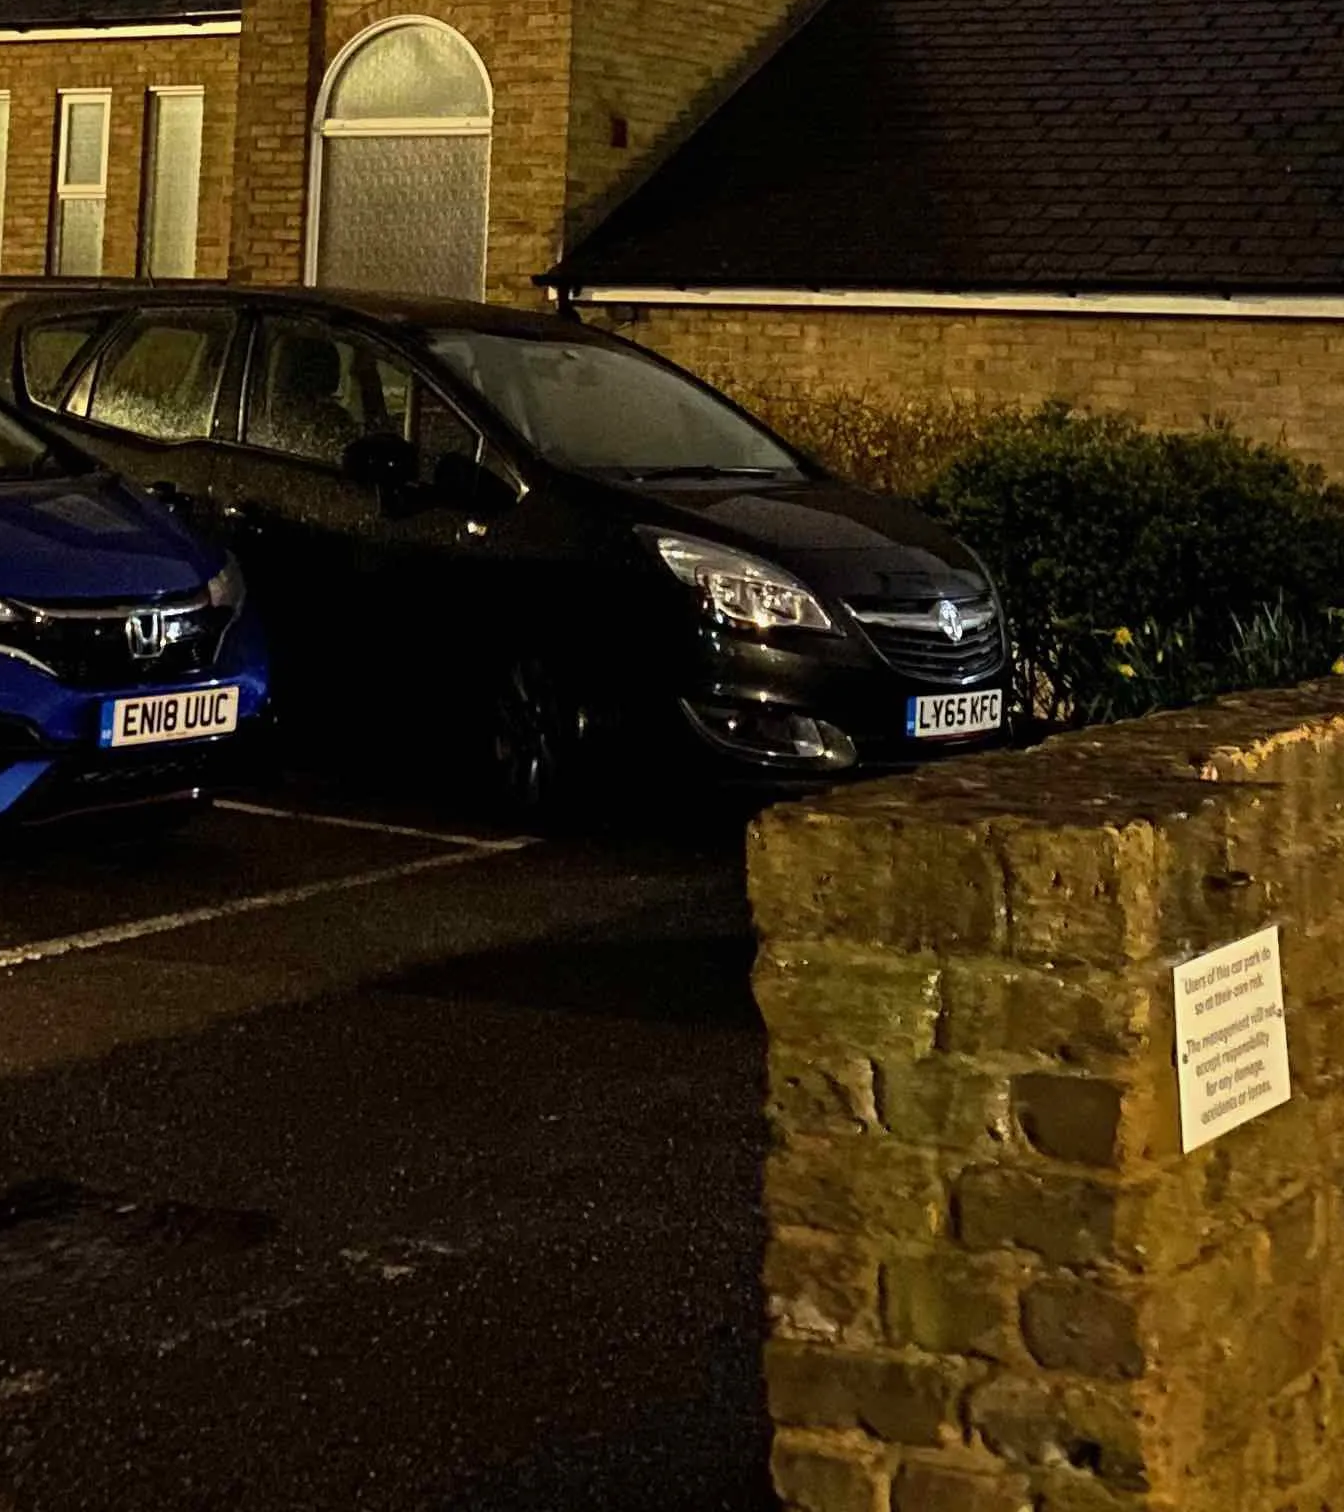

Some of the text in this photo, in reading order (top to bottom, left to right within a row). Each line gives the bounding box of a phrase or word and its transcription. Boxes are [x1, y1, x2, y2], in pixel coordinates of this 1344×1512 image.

[122, 693, 229, 737] EN18 UUC
[919, 694, 998, 729] LY65 KFC
[1184, 976, 1206, 995] Users
[1207, 967, 1215, 985] of
[1231, 959, 1243, 974] car
[1244, 951, 1260, 973] park
